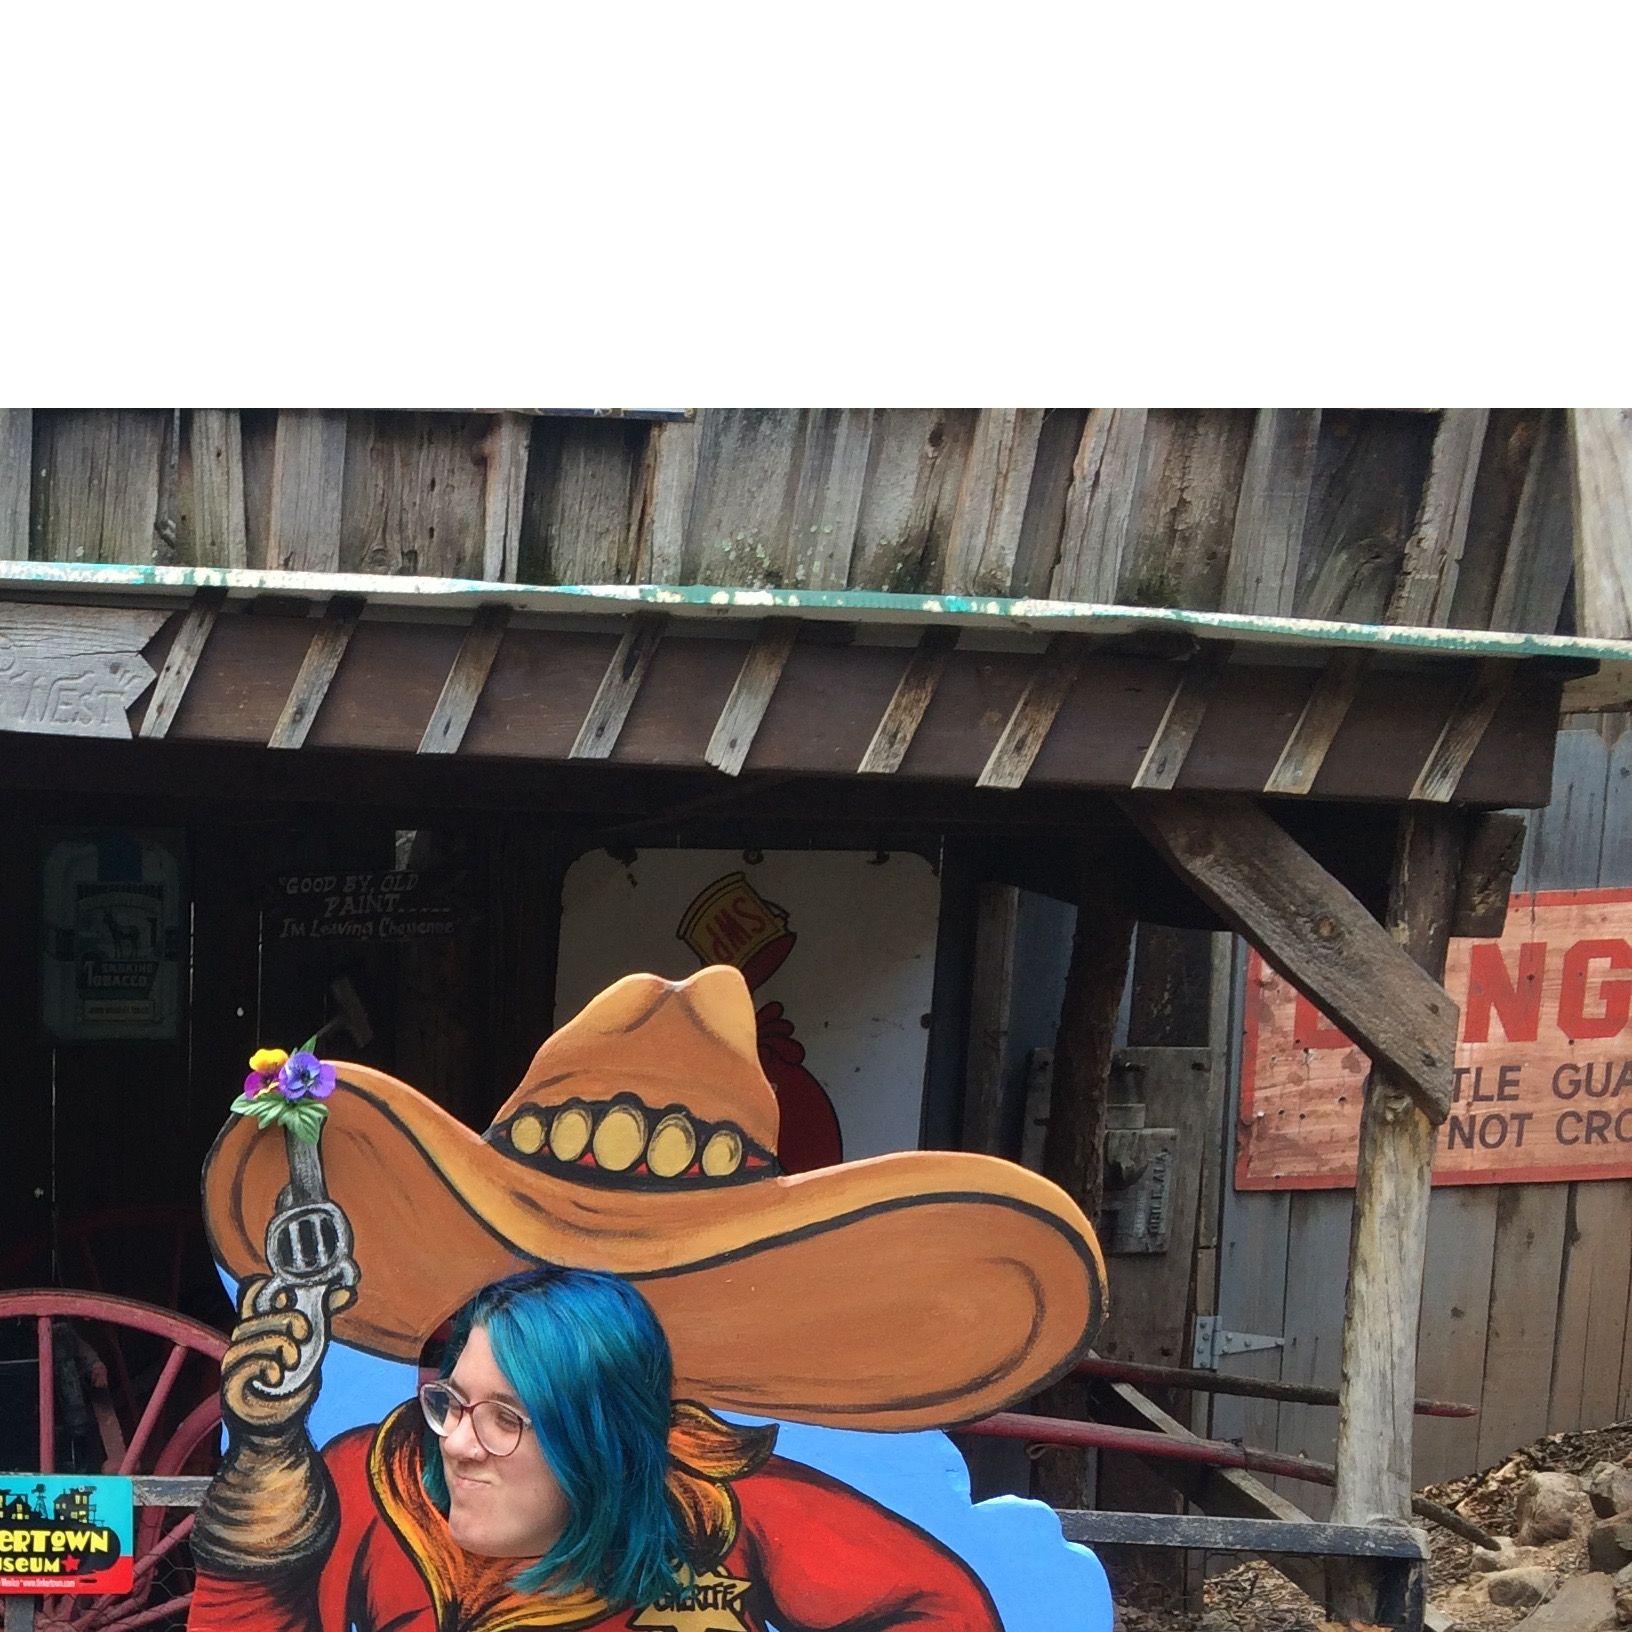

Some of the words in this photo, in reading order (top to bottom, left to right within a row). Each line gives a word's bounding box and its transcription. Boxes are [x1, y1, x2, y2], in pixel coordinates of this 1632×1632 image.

[380, 874, 418, 893] OLD
[1452, 1064, 1521, 1103] TLE
[1447, 1112, 1533, 1150] NOT
